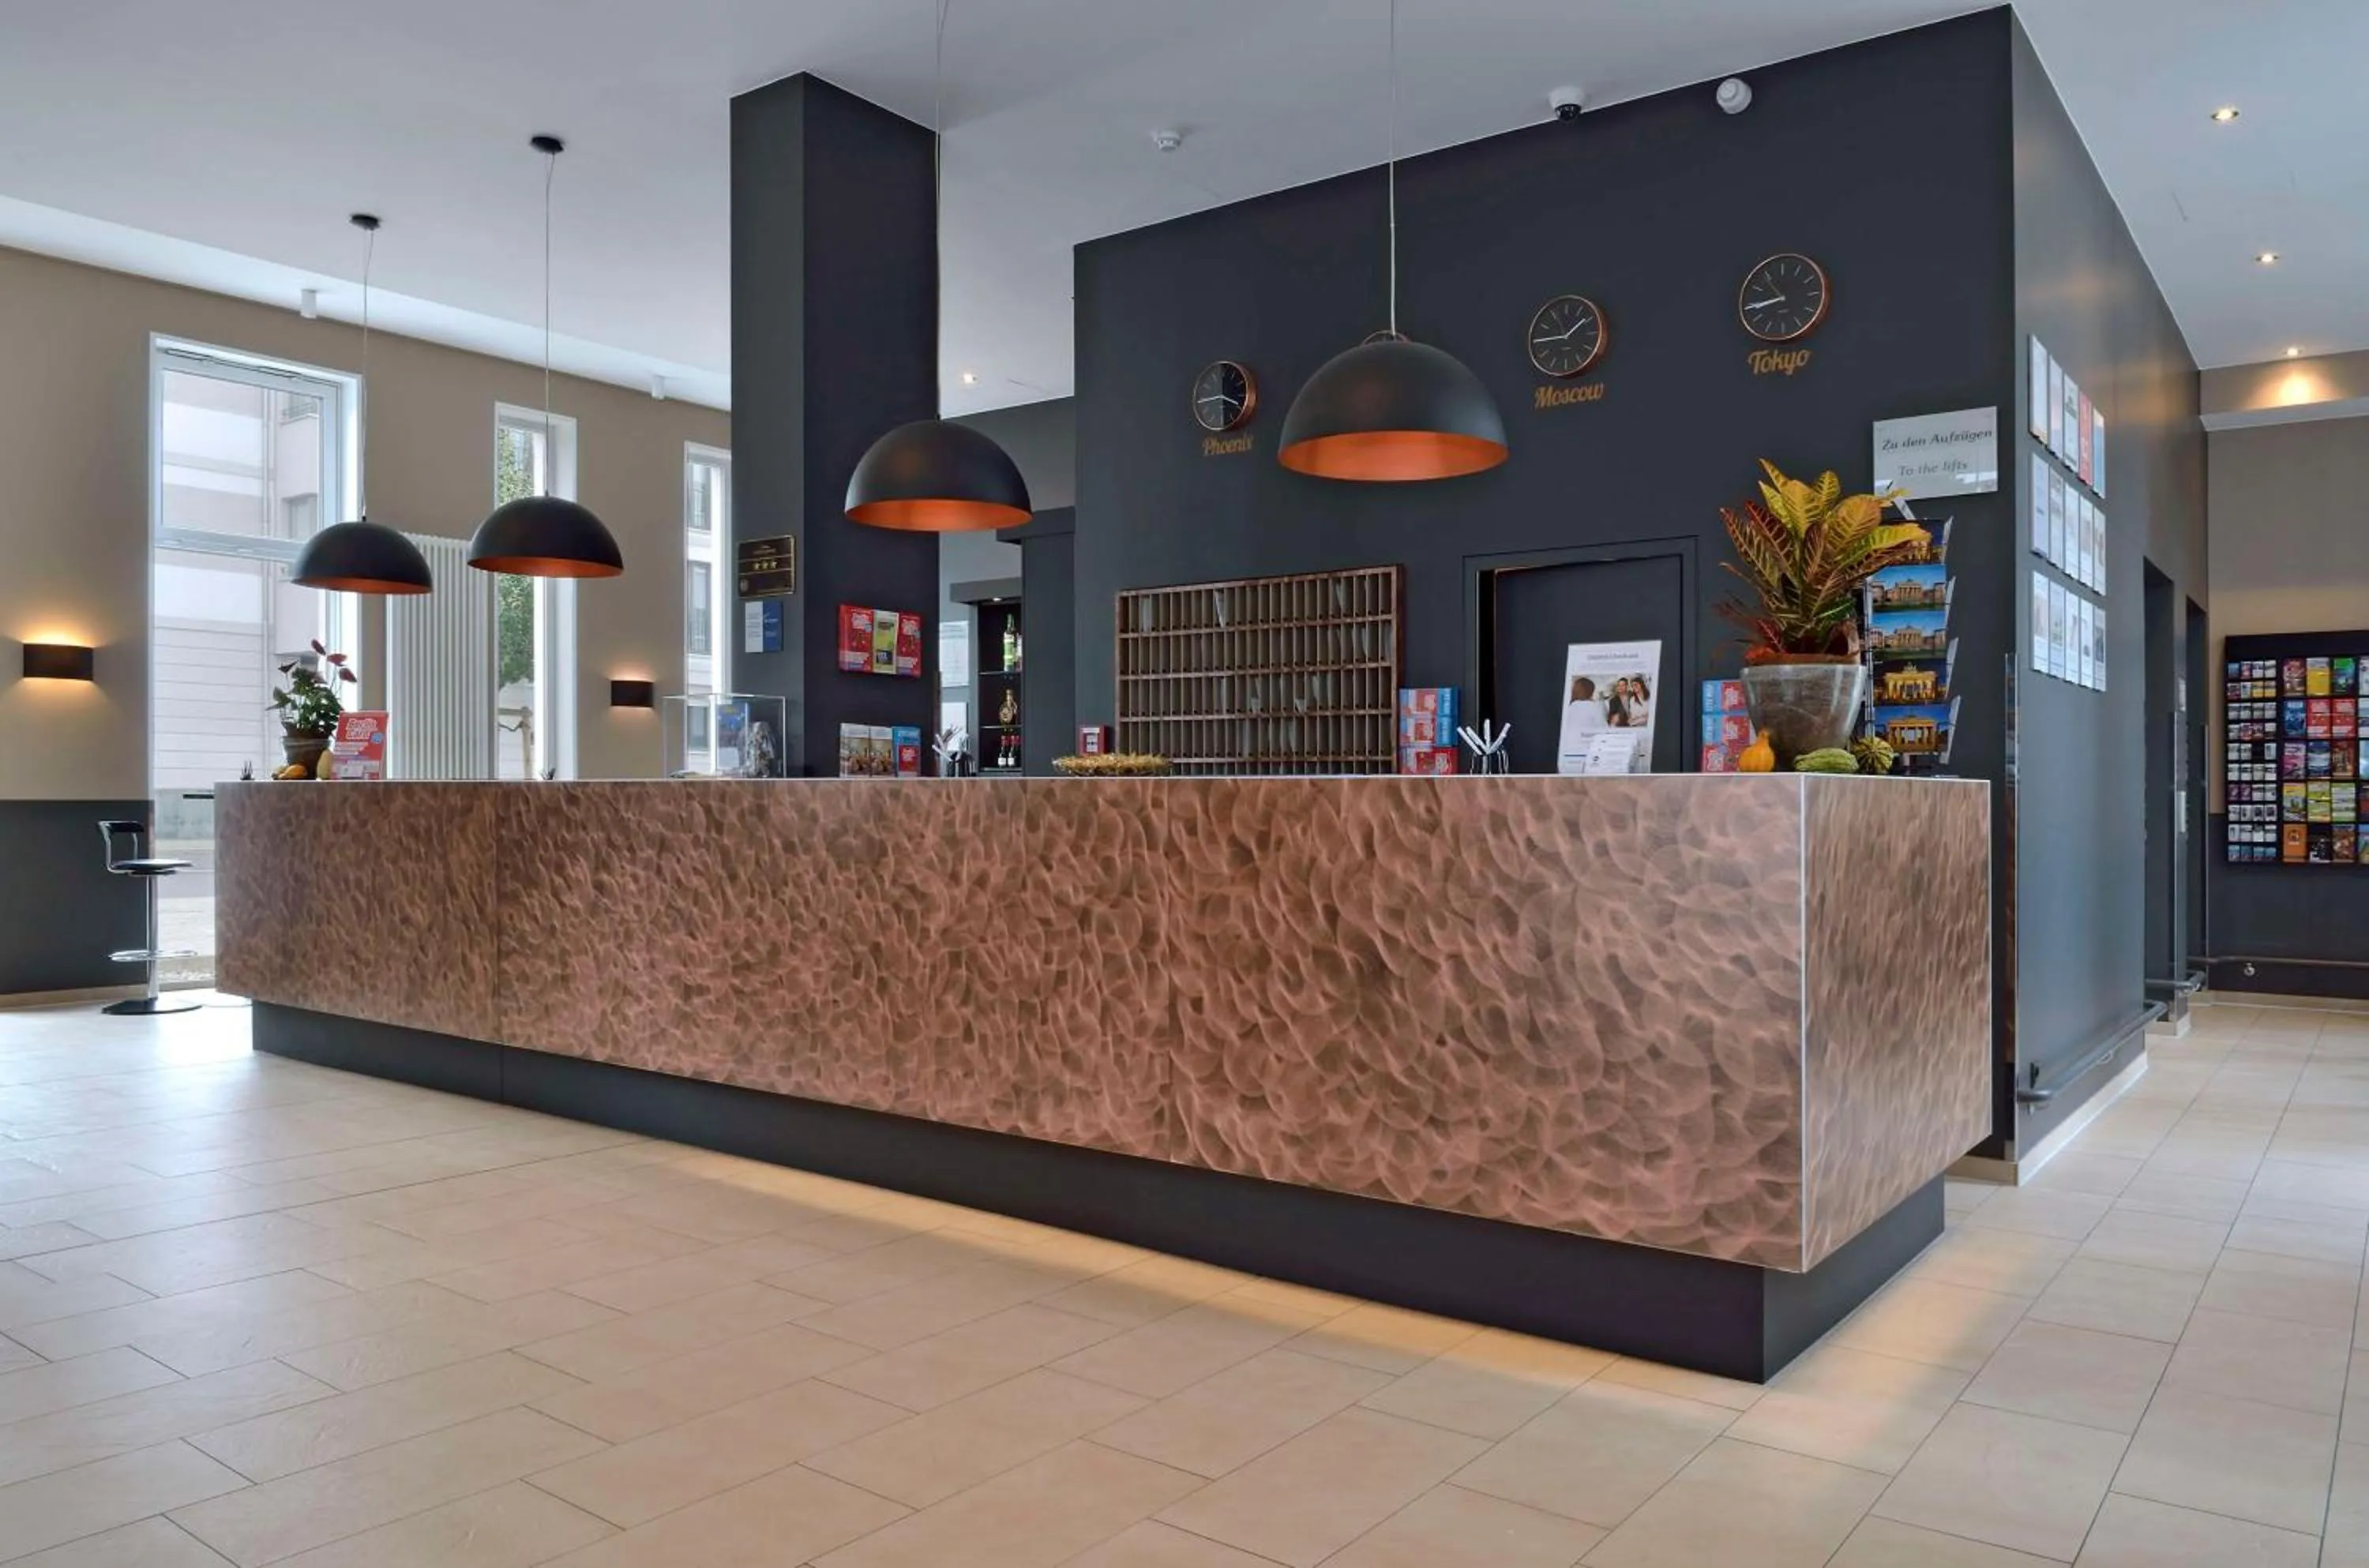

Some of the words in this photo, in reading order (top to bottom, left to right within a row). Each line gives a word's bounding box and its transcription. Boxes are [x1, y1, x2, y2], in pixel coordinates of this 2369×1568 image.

[1748, 348, 1812, 376] Tokyo
[1534, 383, 1604, 409] Moscow
[1882, 438, 1898, 451] Zu
[1902, 436, 1926, 448] den
[1930, 429, 1992, 444] Aufzügen
[1898, 465, 1913, 476] To
[1918, 462, 1939, 475] the
[1942, 459, 1968, 472] lifts
